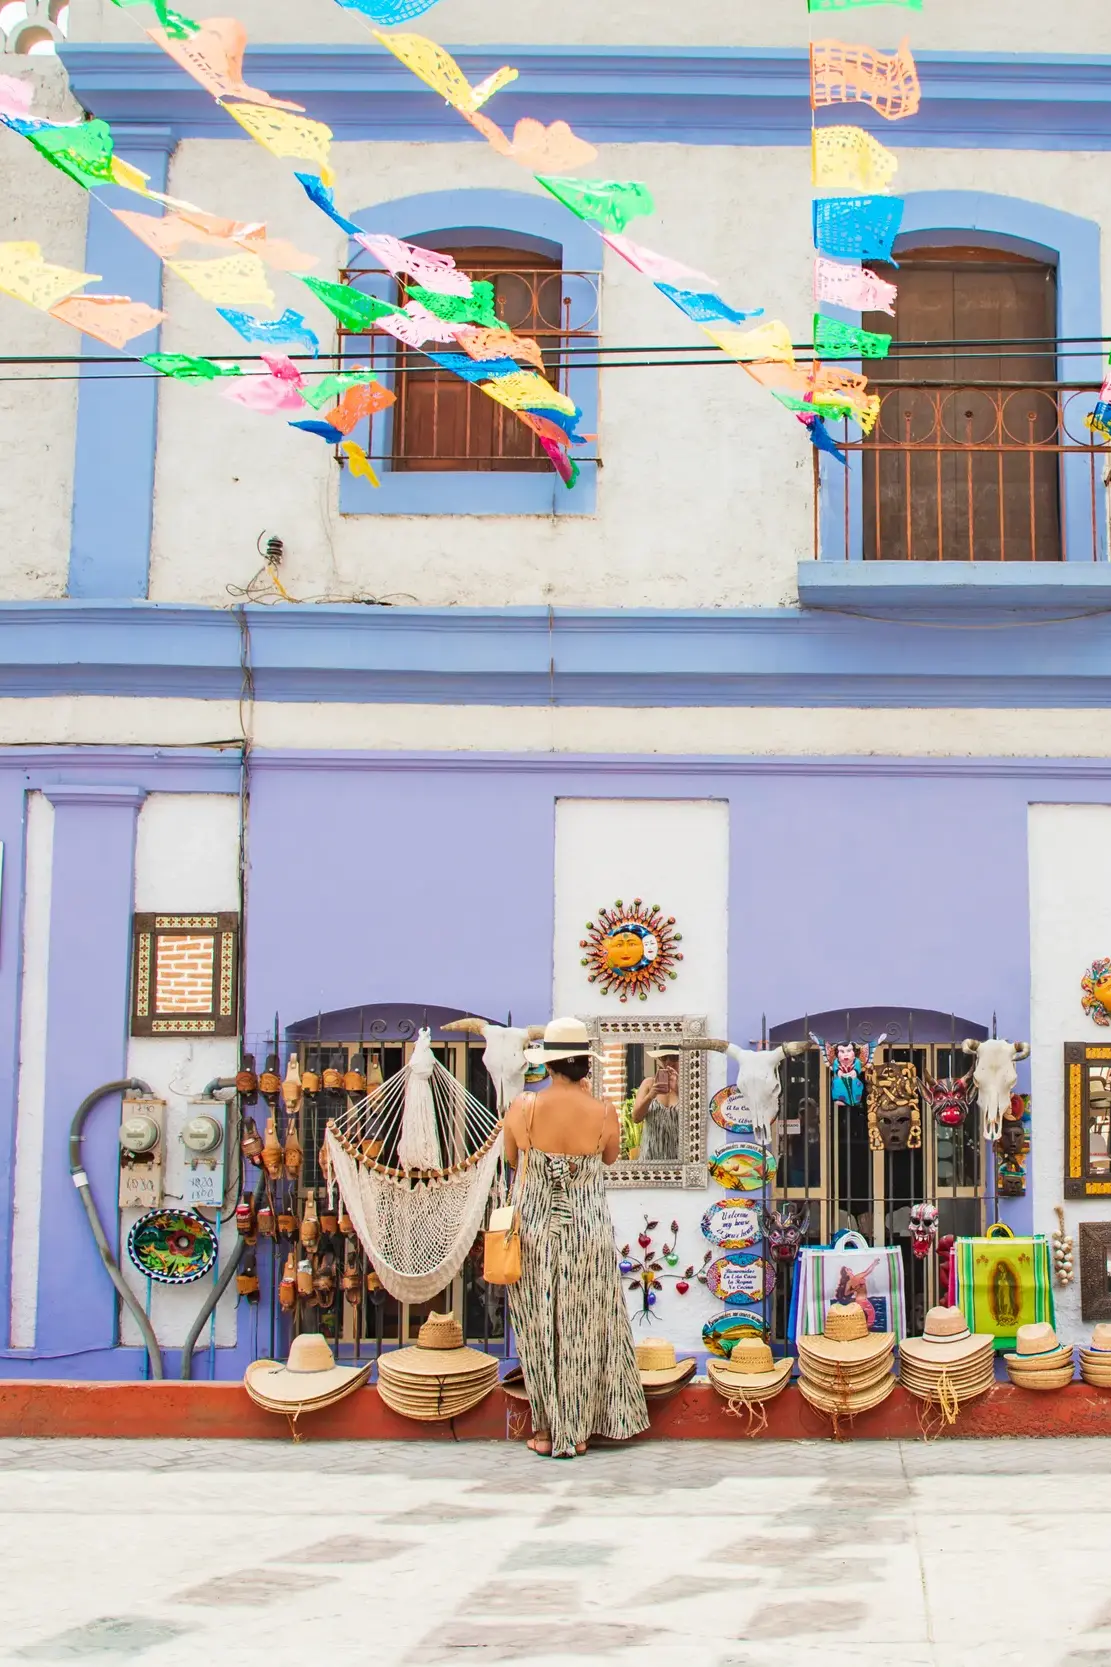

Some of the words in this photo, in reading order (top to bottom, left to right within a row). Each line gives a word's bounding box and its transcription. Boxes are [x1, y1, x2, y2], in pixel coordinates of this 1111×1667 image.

[722, 1210, 748, 1221] Welcome
[722, 1222, 733, 1230] my
[734, 1219, 750, 1227] house
[740, 1225, 754, 1237] house
